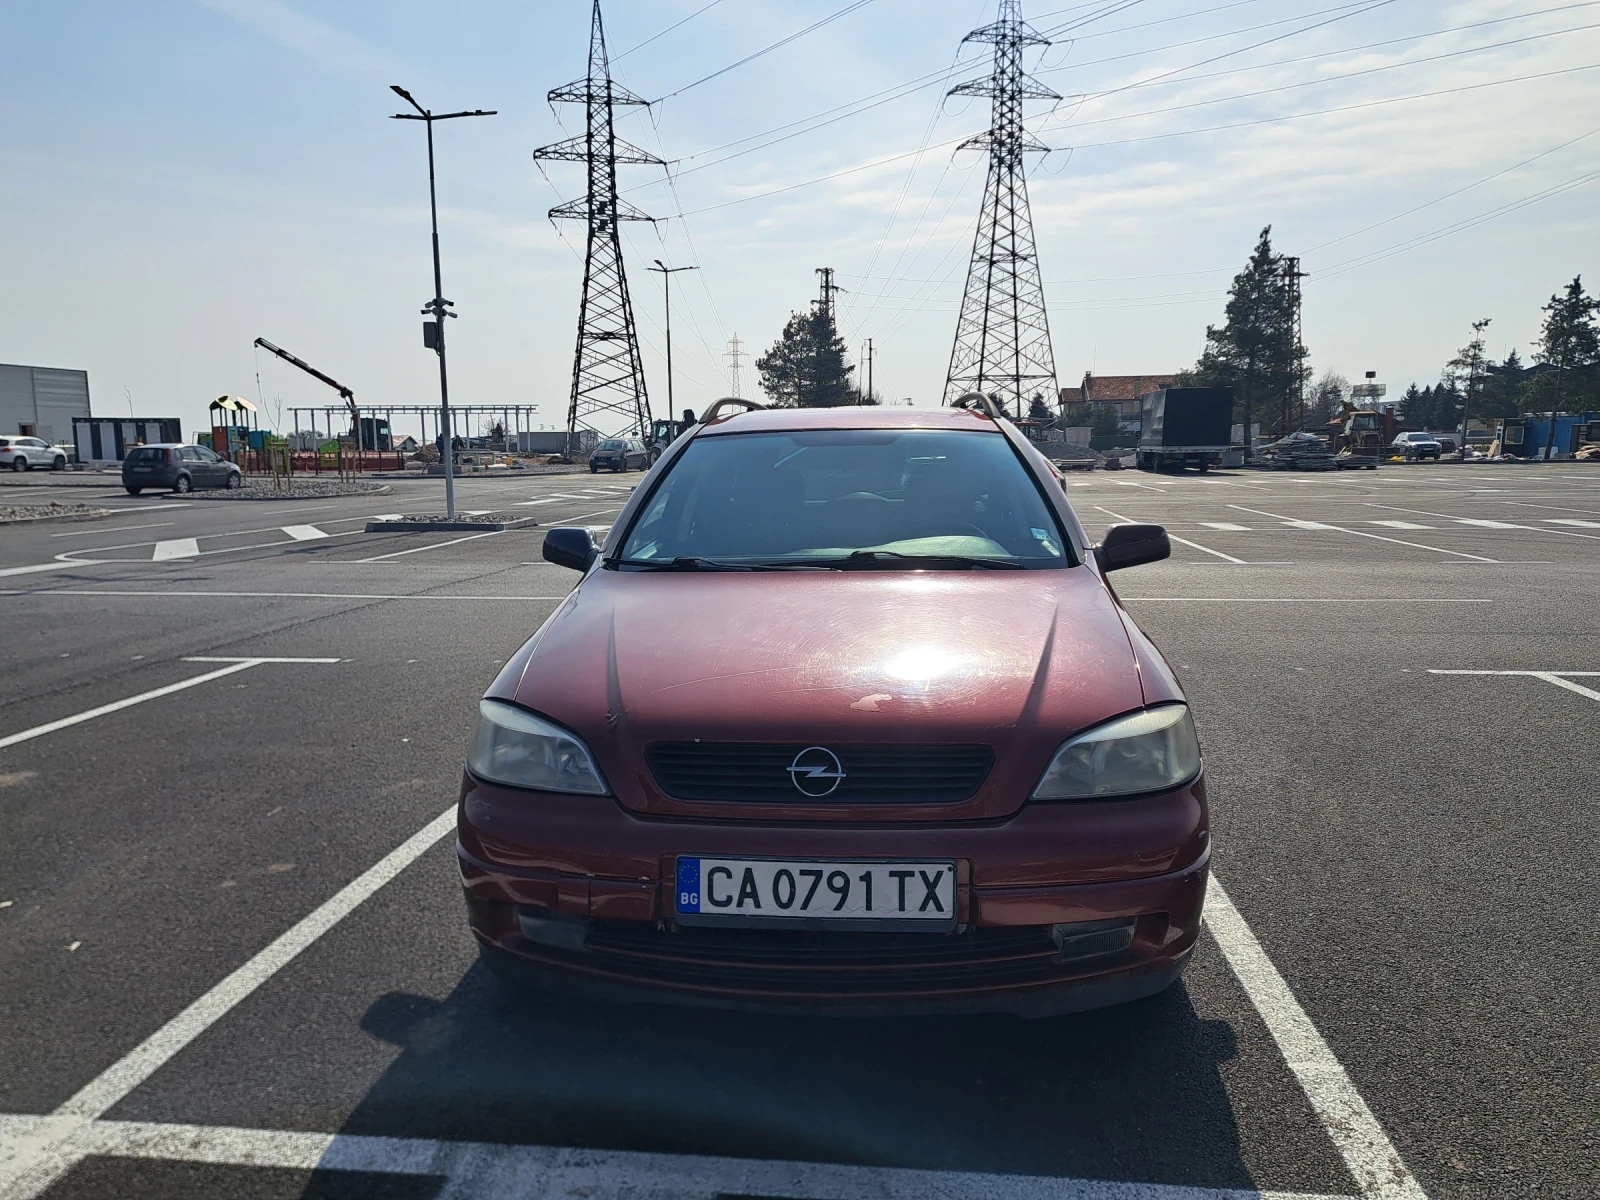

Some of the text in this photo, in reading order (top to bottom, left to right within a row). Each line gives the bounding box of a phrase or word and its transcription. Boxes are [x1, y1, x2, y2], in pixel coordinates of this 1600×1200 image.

[680, 892, 698, 905] BG
[707, 866, 945, 912] CA 0791 TX
